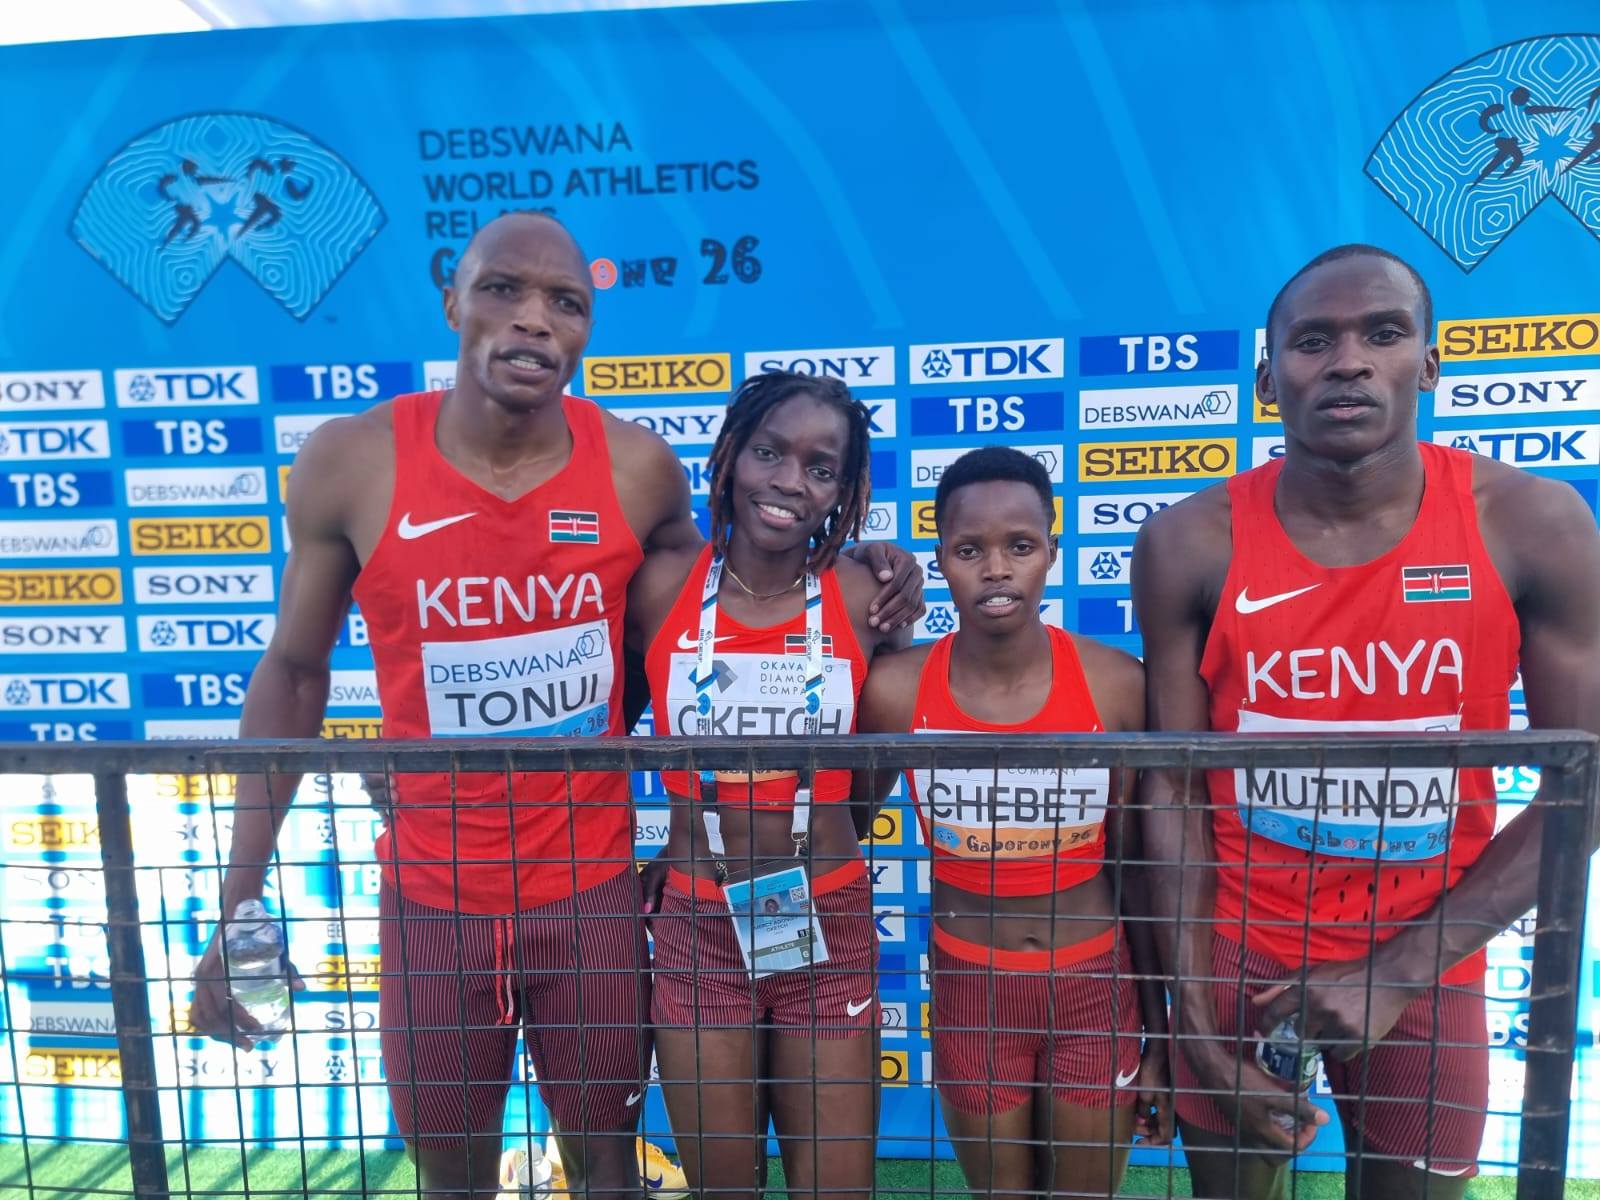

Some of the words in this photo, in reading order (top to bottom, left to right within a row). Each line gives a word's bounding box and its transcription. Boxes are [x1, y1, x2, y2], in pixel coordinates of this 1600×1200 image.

[419, 122, 632, 161] DEBSWANA
[424, 169, 553, 203] WORLD
[564, 160, 760, 198] ATHLETICS
[699, 236, 763, 285] 26
[1444, 319, 1599, 356] SEIKO
[951, 344, 1051, 377] TDK
[1119, 334, 1199, 373] TBS
[154, 372, 246, 401] TDK
[305, 364, 379, 400] TBS
[590, 359, 724, 391] SEIKO
[0, 380, 87, 403] ONY
[1451, 379, 1587, 408] SONY
[632, 415, 718, 436] NY
[949, 396, 1025, 433] TBS
[1084, 403, 1206, 424] DEBSWANA
[8, 427, 97, 454] TDK
[154, 420, 228, 455] TBS
[1479, 430, 1587, 463] TDK
[1085, 443, 1231, 477] SEIKO
[9, 473, 80, 508] TBS
[131, 482, 238, 502] DEBSWANA
[1093, 502, 1169, 525] SO
[0, 536, 92, 553] EBSWANA
[136, 522, 264, 551] SEIKO
[0, 573, 116, 601] SEIKO
[148, 574, 259, 596] SONY
[416, 572, 605, 629] KENYA
[2, 624, 110, 647] SONY
[175, 619, 266, 647] TDK
[430, 648, 582, 684] DEBSWANA
[760, 660, 833, 673] OKAVAO
[760, 673, 826, 684] DIAMOD
[1247, 638, 1462, 703] KENYA
[30, 678, 119, 705] TDK
[175, 674, 245, 706] TBS
[445, 673, 598, 728] TONUI
[760, 685, 826, 696] COMPAY
[1246, 768, 1448, 819] MUTINDA
[1491, 766, 1541, 792] BS
[927, 782, 1097, 822] CHEBET
[11, 821, 101, 846] SEIK
[325, 1010, 375, 1031] SO
[1487, 1011, 1530, 1046] BS
[25, 1053, 120, 1078] SEIK
